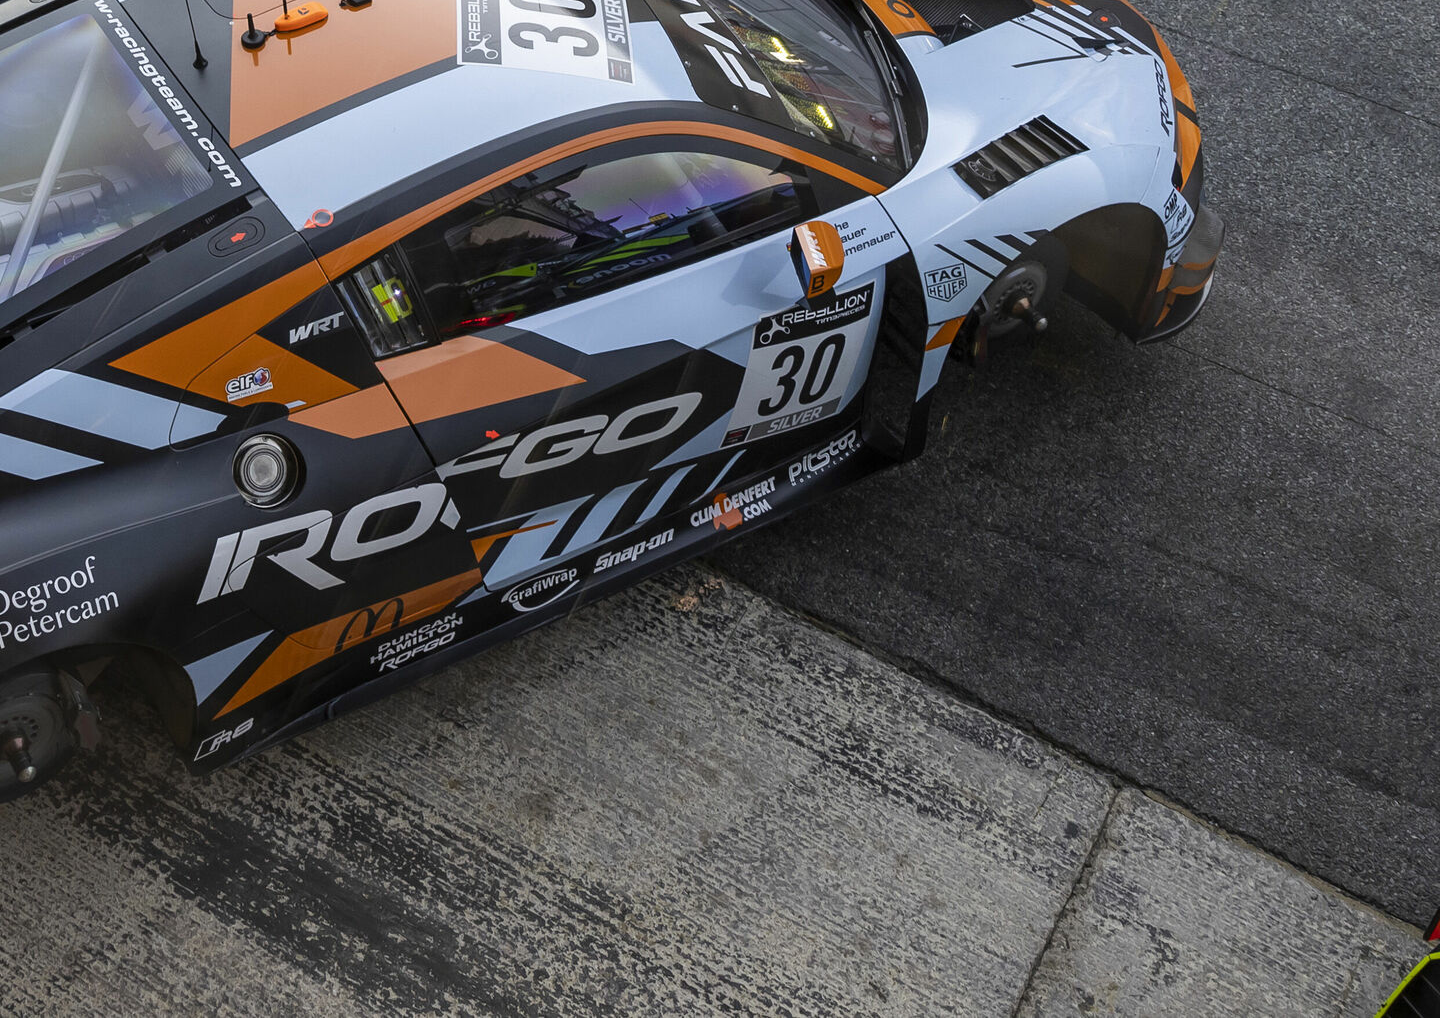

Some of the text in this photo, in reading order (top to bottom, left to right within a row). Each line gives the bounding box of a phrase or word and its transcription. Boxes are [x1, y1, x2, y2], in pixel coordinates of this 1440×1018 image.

[844, 230, 896, 256] menauer
[928, 266, 962, 284] TAG
[928, 279, 966, 301] HEUER
[782, 291, 868, 325] REBELLION
[289, 311, 345, 345] WRT
[226, 375, 256, 394] elf
[757, 333, 847, 417] 30
[767, 406, 824, 432] SILVER
[723, 476, 777, 512] DENFERT
[743, 498, 773, 522] .COM
[593, 528, 675, 574] Snap-on
[509, 568, 578, 604] GrafiWrap
[370, 616, 464, 665] HAMILTON
[378, 612, 457, 653] DUNCAN
[378, 631, 456, 672] ROFGO
